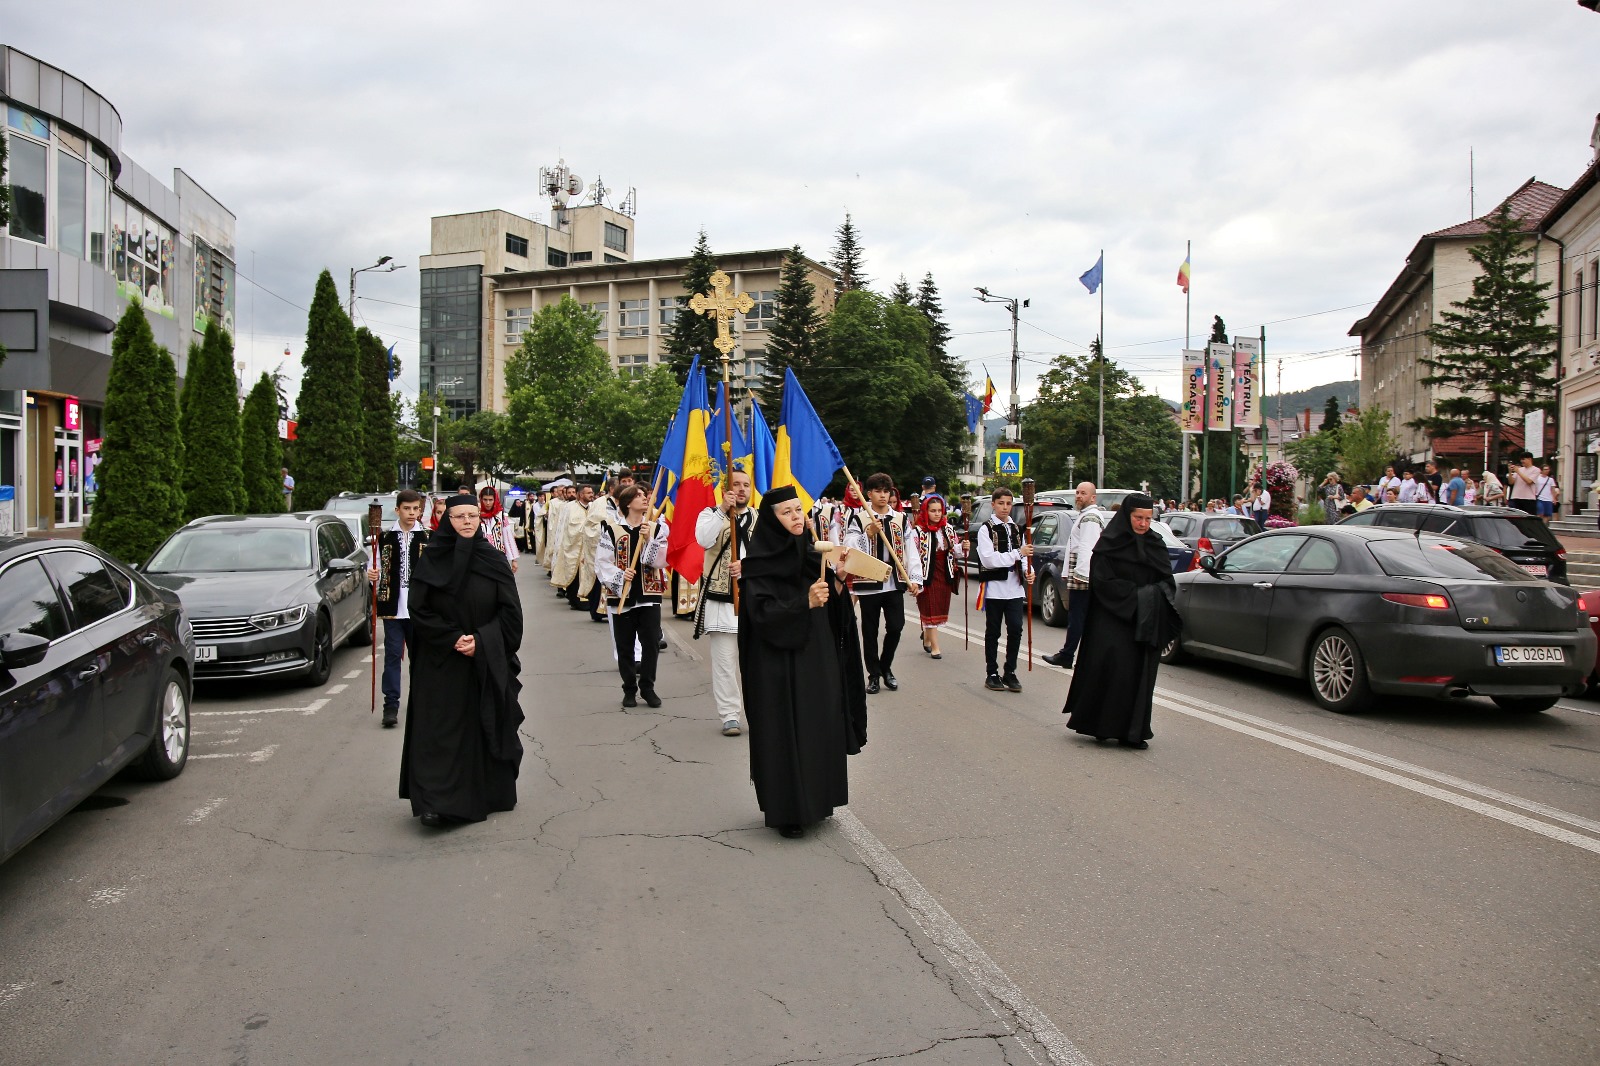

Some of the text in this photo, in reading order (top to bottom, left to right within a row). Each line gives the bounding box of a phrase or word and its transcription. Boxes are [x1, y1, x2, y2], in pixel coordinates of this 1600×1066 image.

[1243, 361, 1252, 417] TEATRUL
[69, 404, 78, 425] T
[1501, 648, 1563, 661] BC 02GAD
